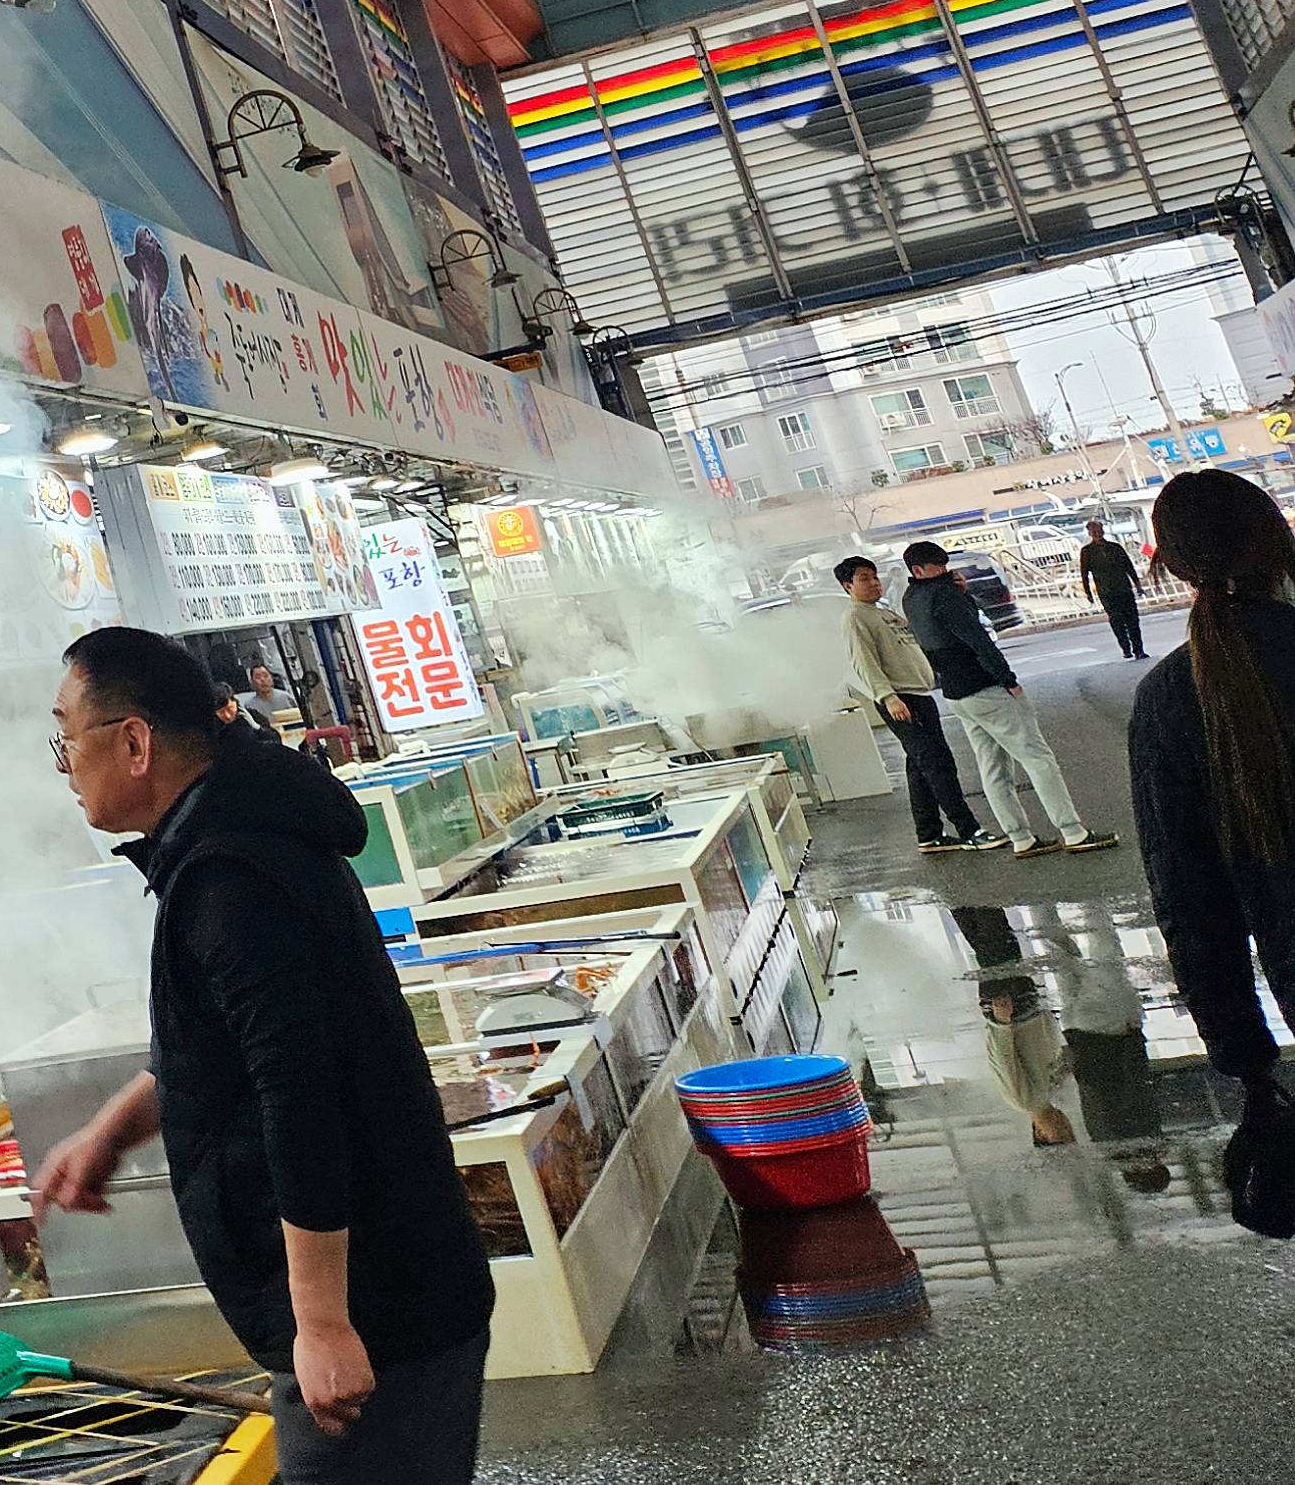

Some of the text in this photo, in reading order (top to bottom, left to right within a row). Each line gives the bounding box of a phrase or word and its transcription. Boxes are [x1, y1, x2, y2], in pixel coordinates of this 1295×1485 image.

[316, 310, 403, 426] 맛있는
[393, 343, 445, 442] 포항
[379, 560, 426, 590] 포항
[362, 610, 453, 671] 물회
[375, 659, 468, 719] 전문
